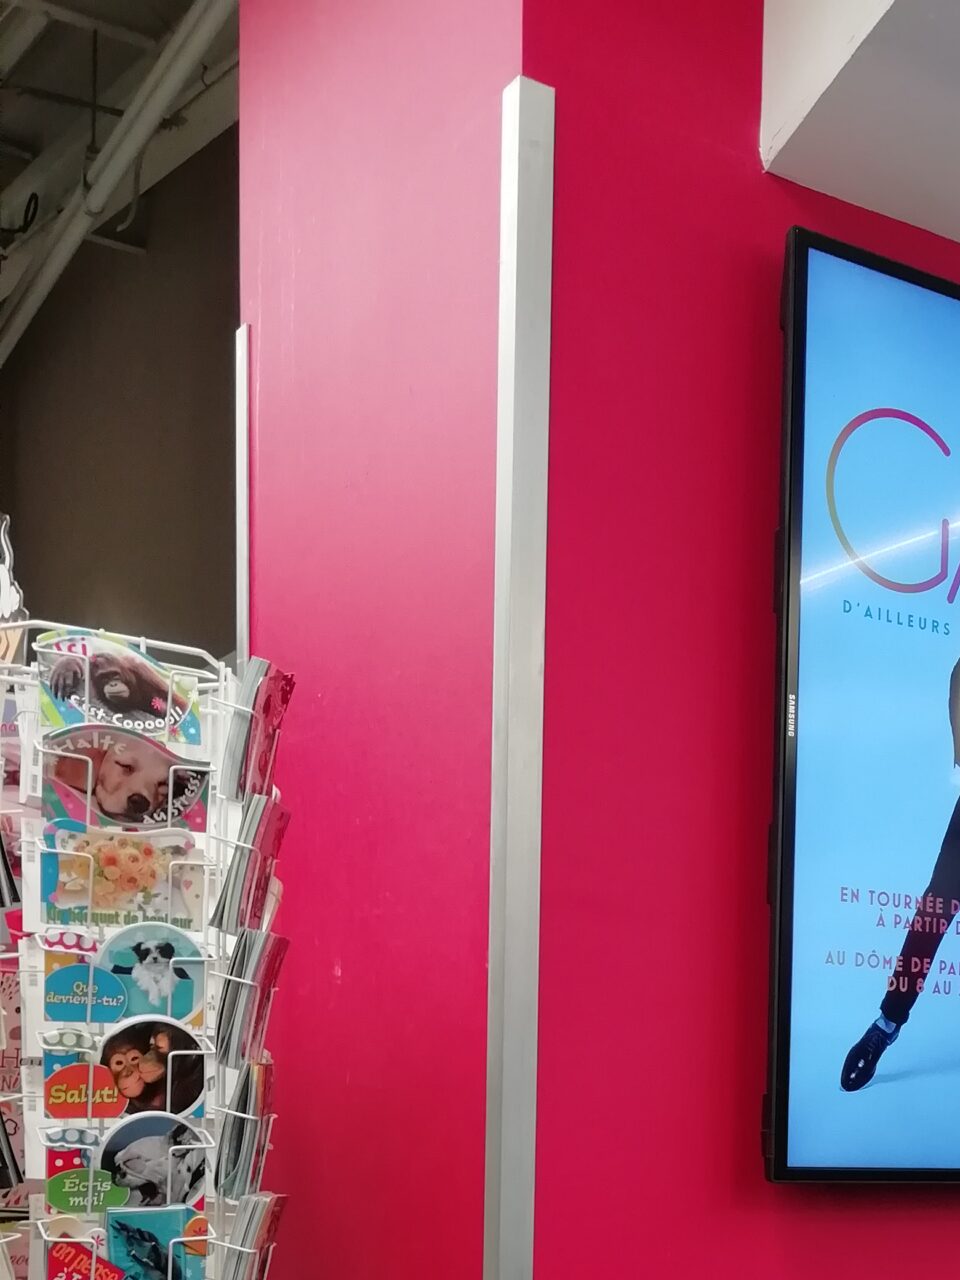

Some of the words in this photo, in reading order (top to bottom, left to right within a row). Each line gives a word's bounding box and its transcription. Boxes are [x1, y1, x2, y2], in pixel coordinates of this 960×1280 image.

[842, 599, 952, 636] D'AILLEURS
[788, 694, 796, 737] SAMSUNG
[840, 886, 860, 903] EN
[868, 889, 944, 914] TOURNÉE
[876, 909, 886, 928] À
[893, 912, 949, 934] PARTIR
[825, 950, 846, 966] AU
[855, 950, 904, 972] DÔME
[911, 957, 931, 974] DE
[887, 976, 909, 993] DU
[932, 980, 951, 996] AU
[46, 992, 125, 1006] deviens-tu?
[48, 1084, 119, 1104] Salut!
[52, 1243, 75, 1262] on
